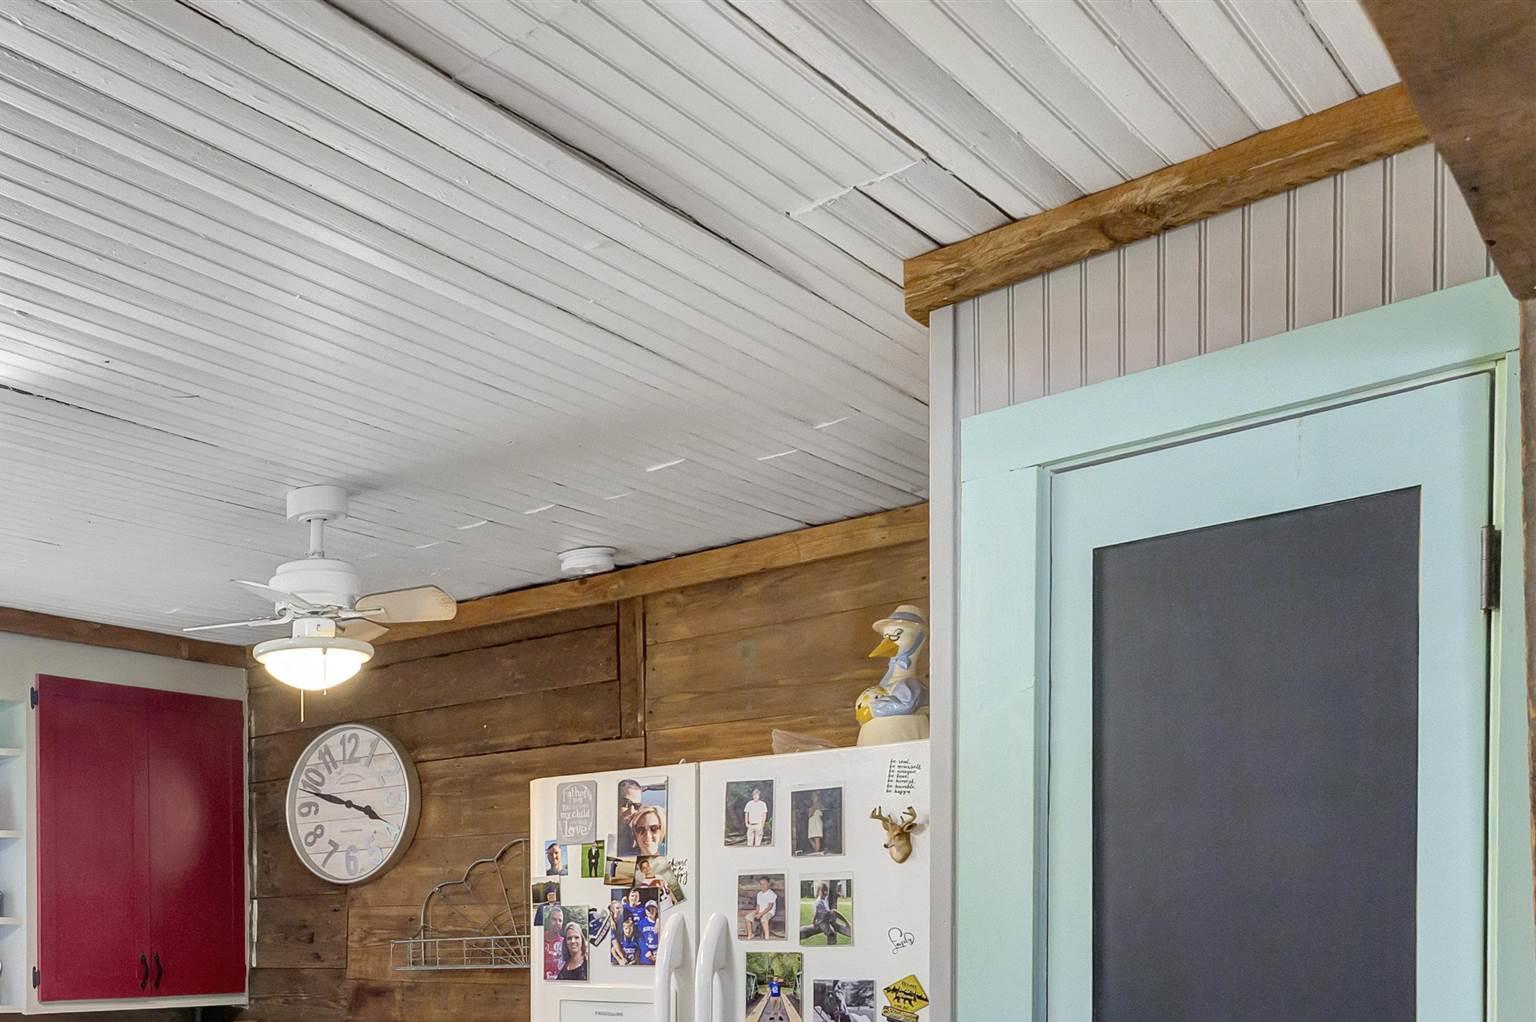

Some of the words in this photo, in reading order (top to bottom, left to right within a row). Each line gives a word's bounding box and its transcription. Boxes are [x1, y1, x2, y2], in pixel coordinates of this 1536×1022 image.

[318, 743, 339, 775] 11
[339, 732, 361, 765] 12
[301, 767, 326, 794] 10
[297, 801, 320, 818] 9
[304, 824, 325, 847] 8
[322, 838, 340, 868] 7
